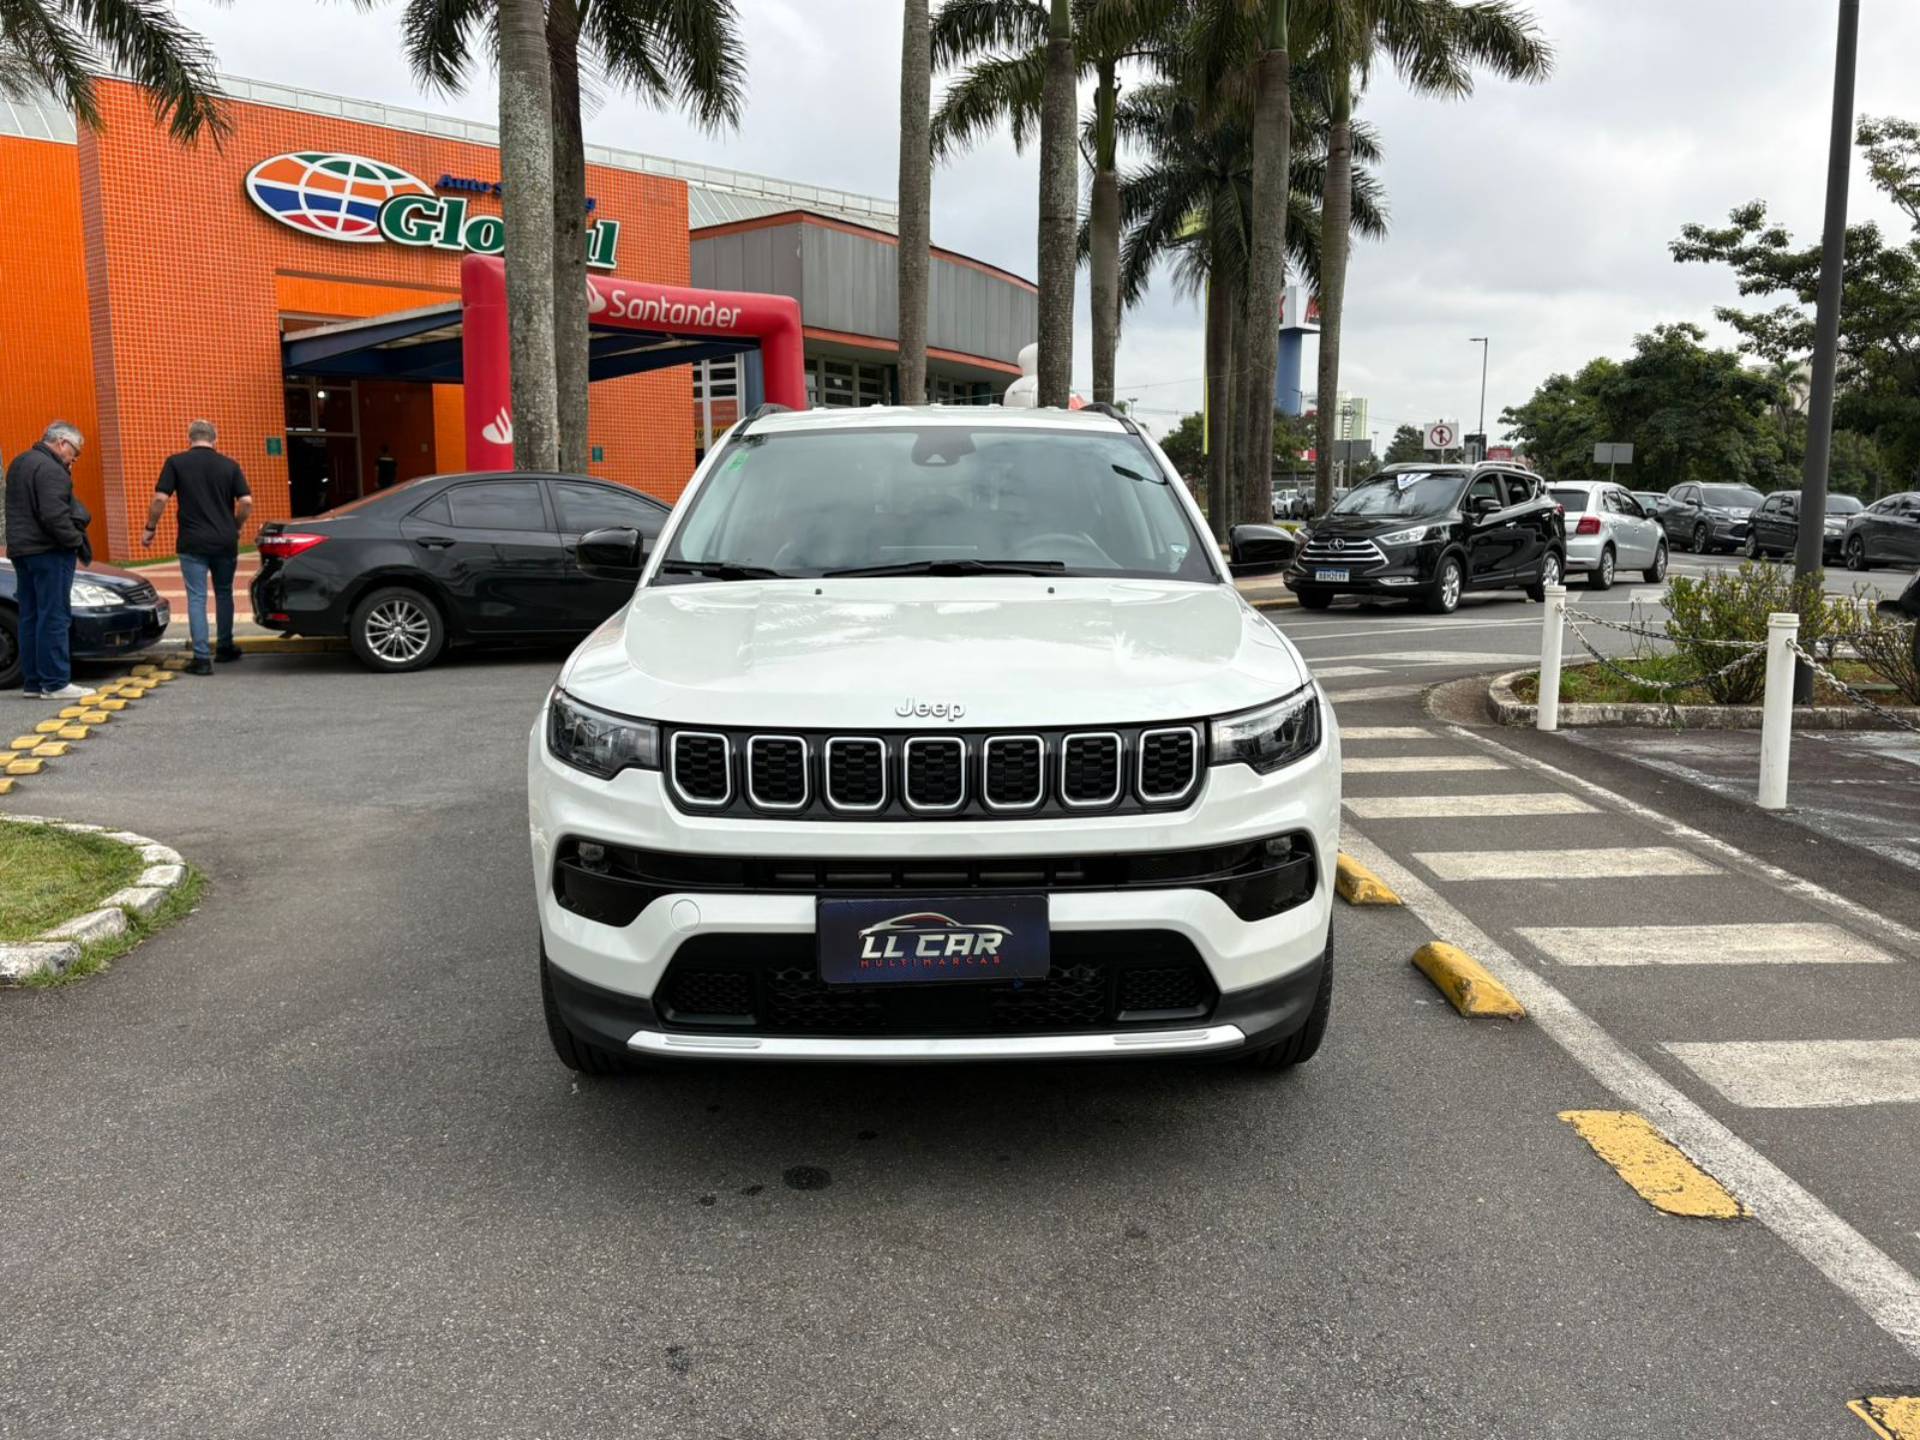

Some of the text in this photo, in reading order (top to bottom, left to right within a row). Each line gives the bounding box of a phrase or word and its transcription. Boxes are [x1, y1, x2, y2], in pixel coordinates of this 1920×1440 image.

[380, 195, 620, 269] Glol
[609, 289, 742, 328] Santander
[895, 697, 966, 722] Jeep
[861, 933, 1003, 958] LL CAR
[859, 955, 1003, 968] MULTIMARCAS
